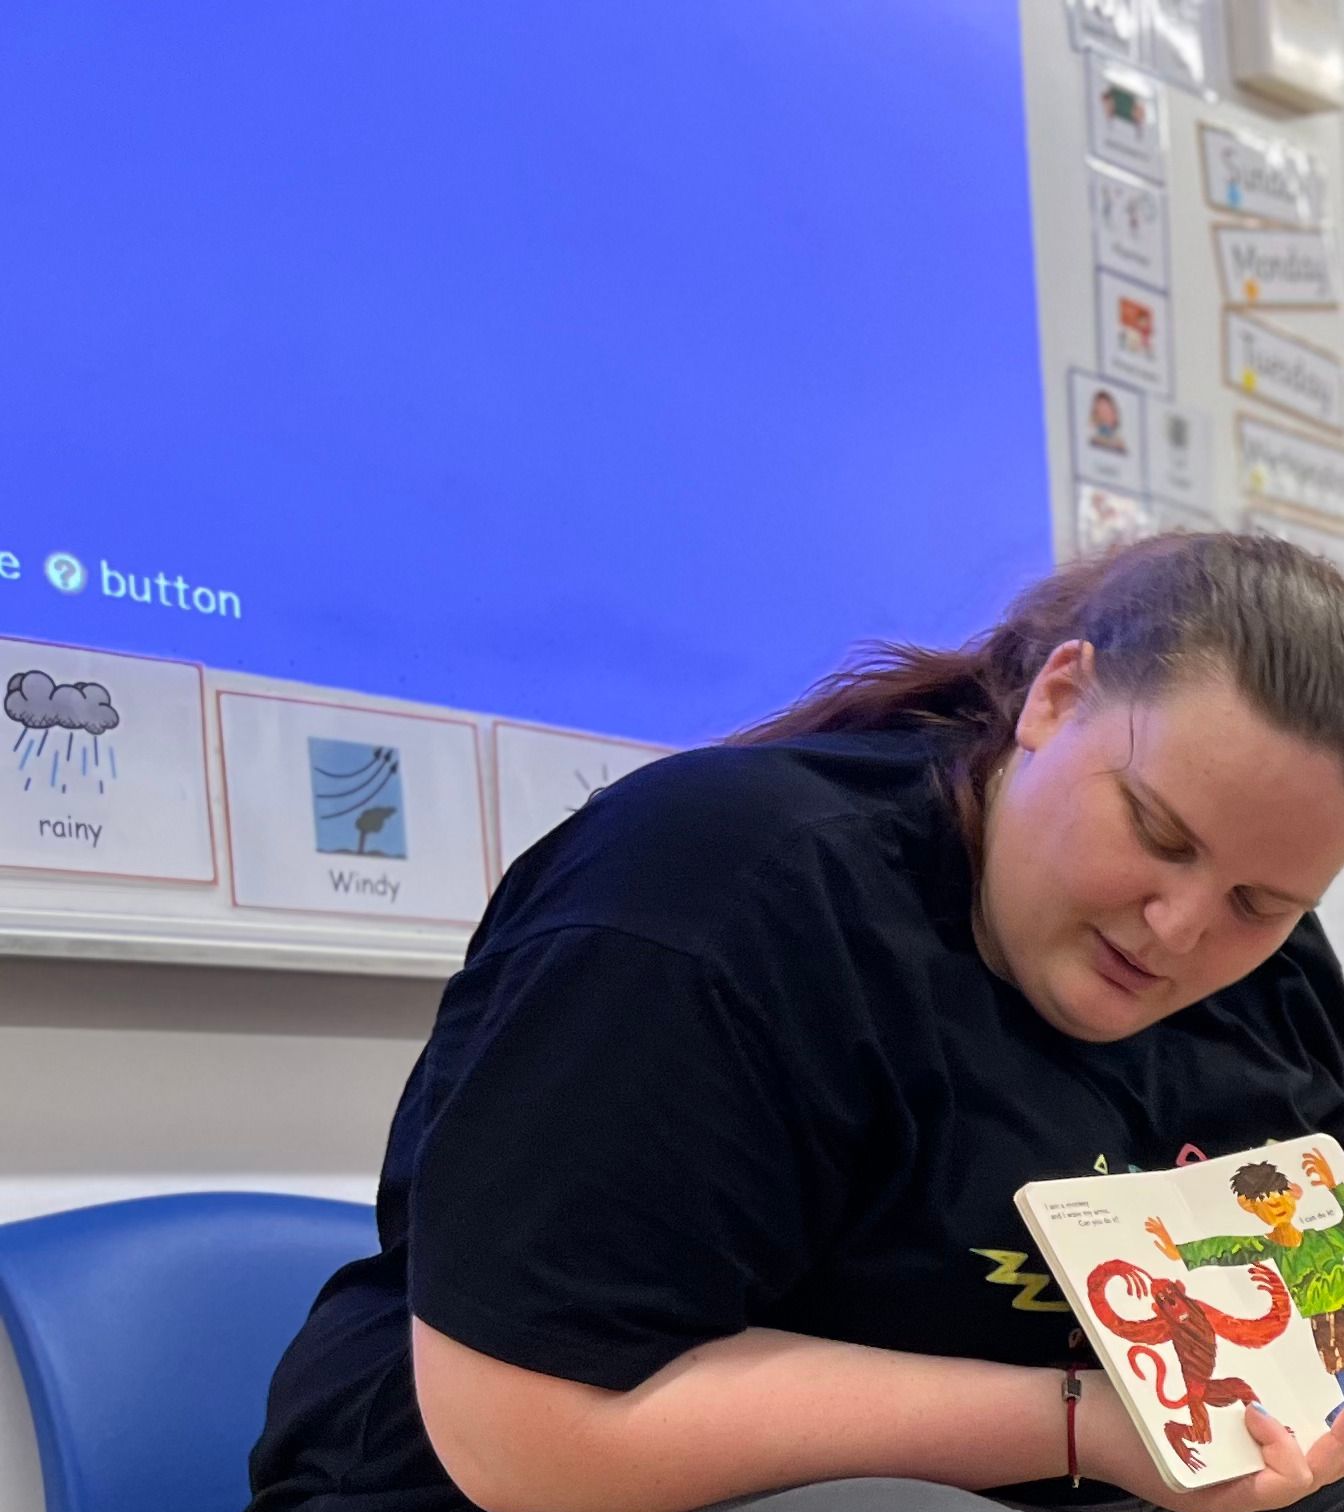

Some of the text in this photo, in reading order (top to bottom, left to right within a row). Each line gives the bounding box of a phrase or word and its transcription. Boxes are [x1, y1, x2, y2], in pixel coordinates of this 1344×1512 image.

[101, 559, 241, 619] button
[38, 815, 103, 848] rainy
[328, 868, 401, 903] Windy
